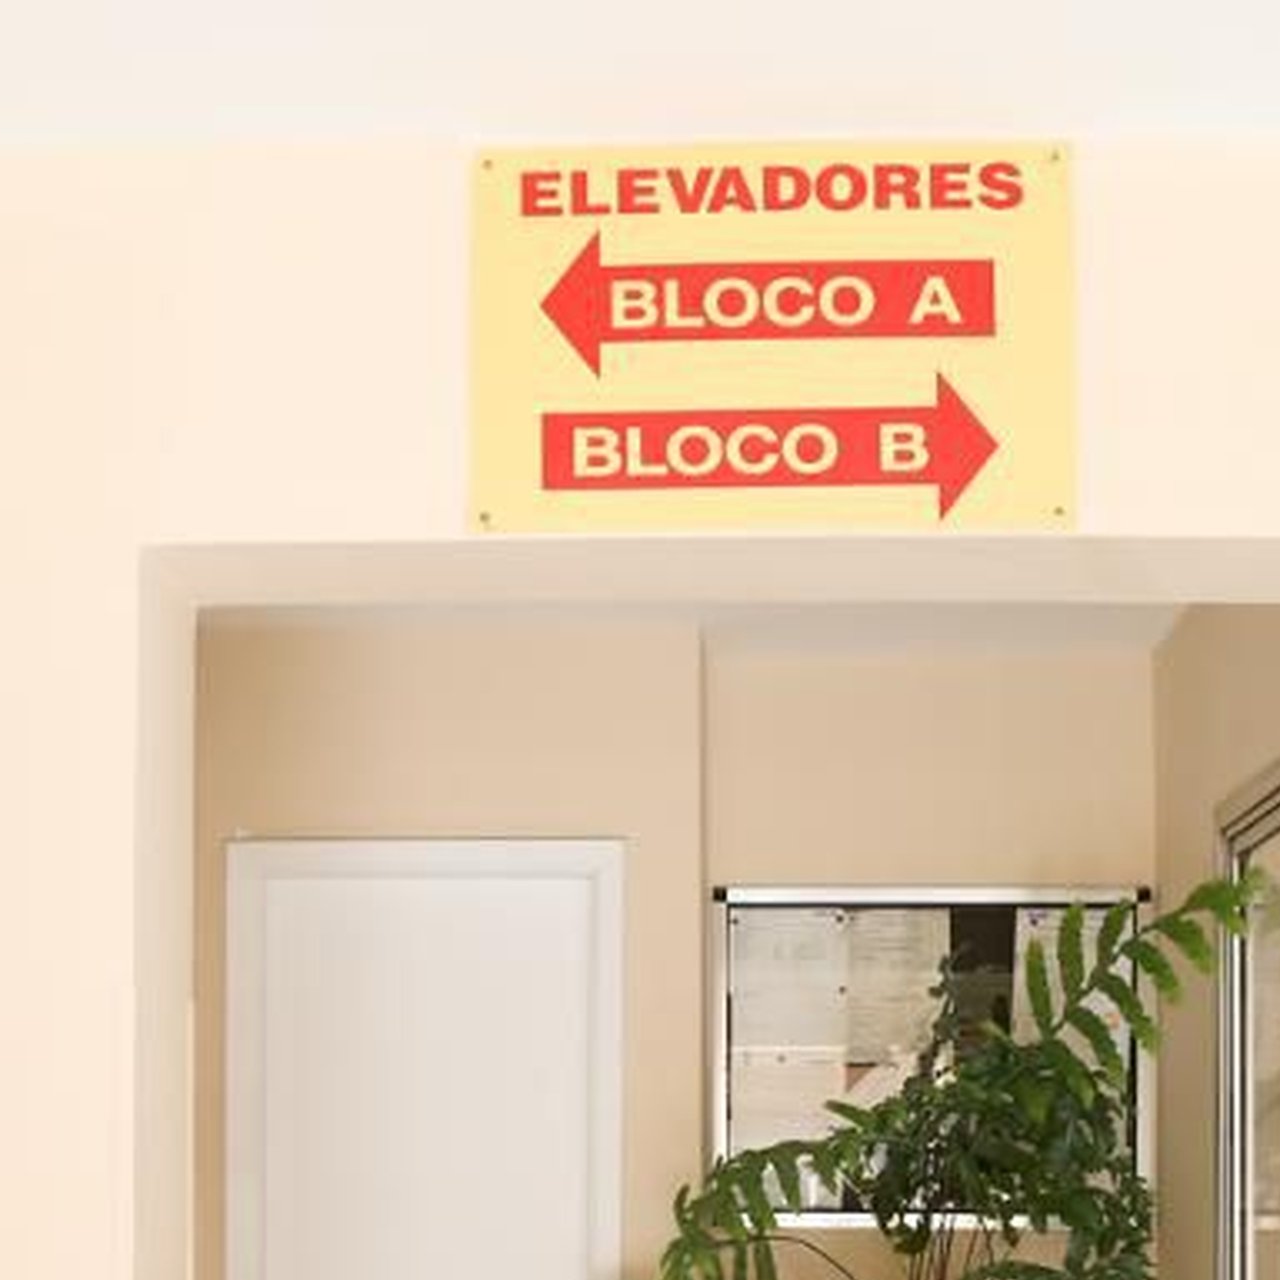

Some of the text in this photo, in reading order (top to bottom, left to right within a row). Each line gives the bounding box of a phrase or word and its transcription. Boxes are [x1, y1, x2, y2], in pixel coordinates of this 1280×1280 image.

[519, 161, 1024, 217] ELEVADORES
[610, 275, 962, 329] BLOCO A
[572, 423, 930, 479] BLOCO B
